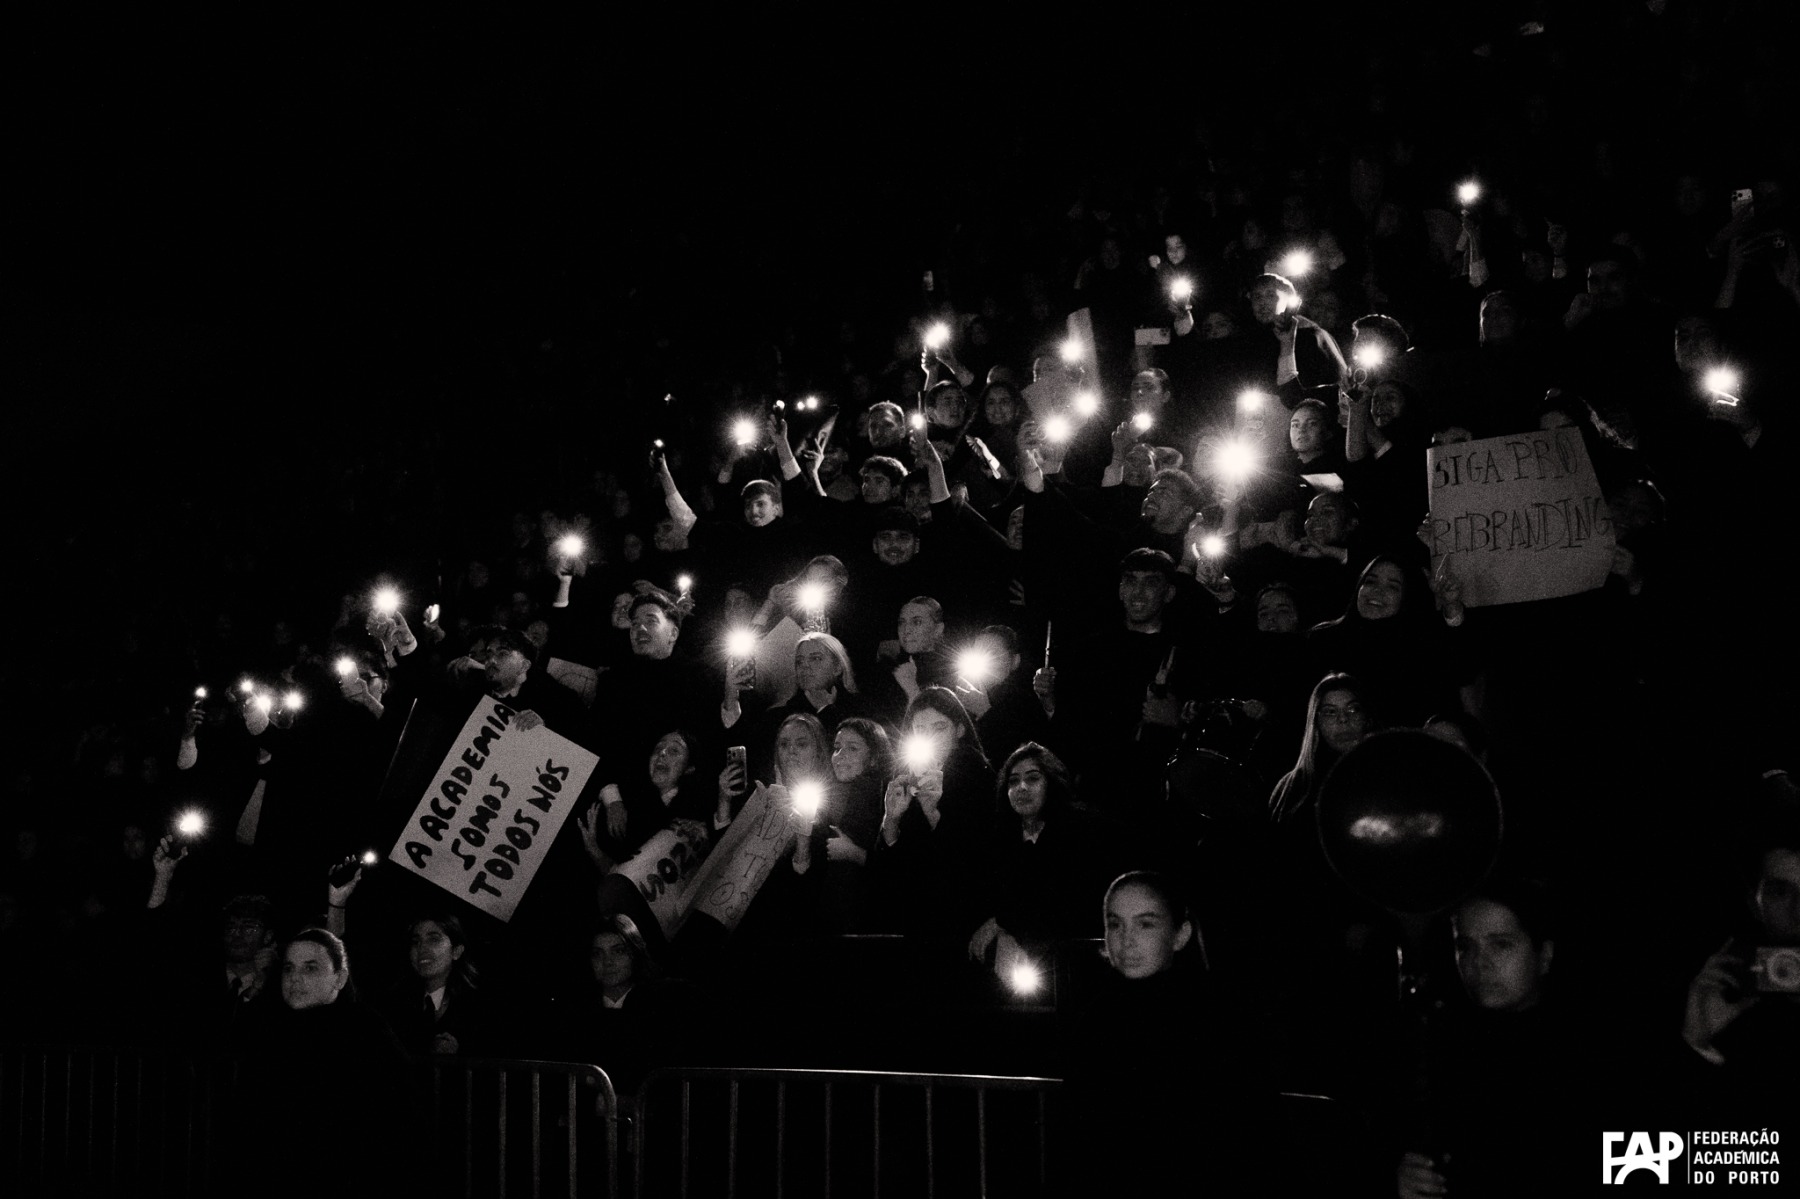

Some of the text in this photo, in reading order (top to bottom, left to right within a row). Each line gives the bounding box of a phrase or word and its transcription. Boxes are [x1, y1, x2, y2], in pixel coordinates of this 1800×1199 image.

[1433, 449, 1504, 489] SIGA
[1431, 497, 1612, 557] REBRANDING
[404, 703, 516, 869] A ACADEMIA
[451, 773, 511, 871] SOMOS
[468, 758, 570, 897] TODOS NÓS
